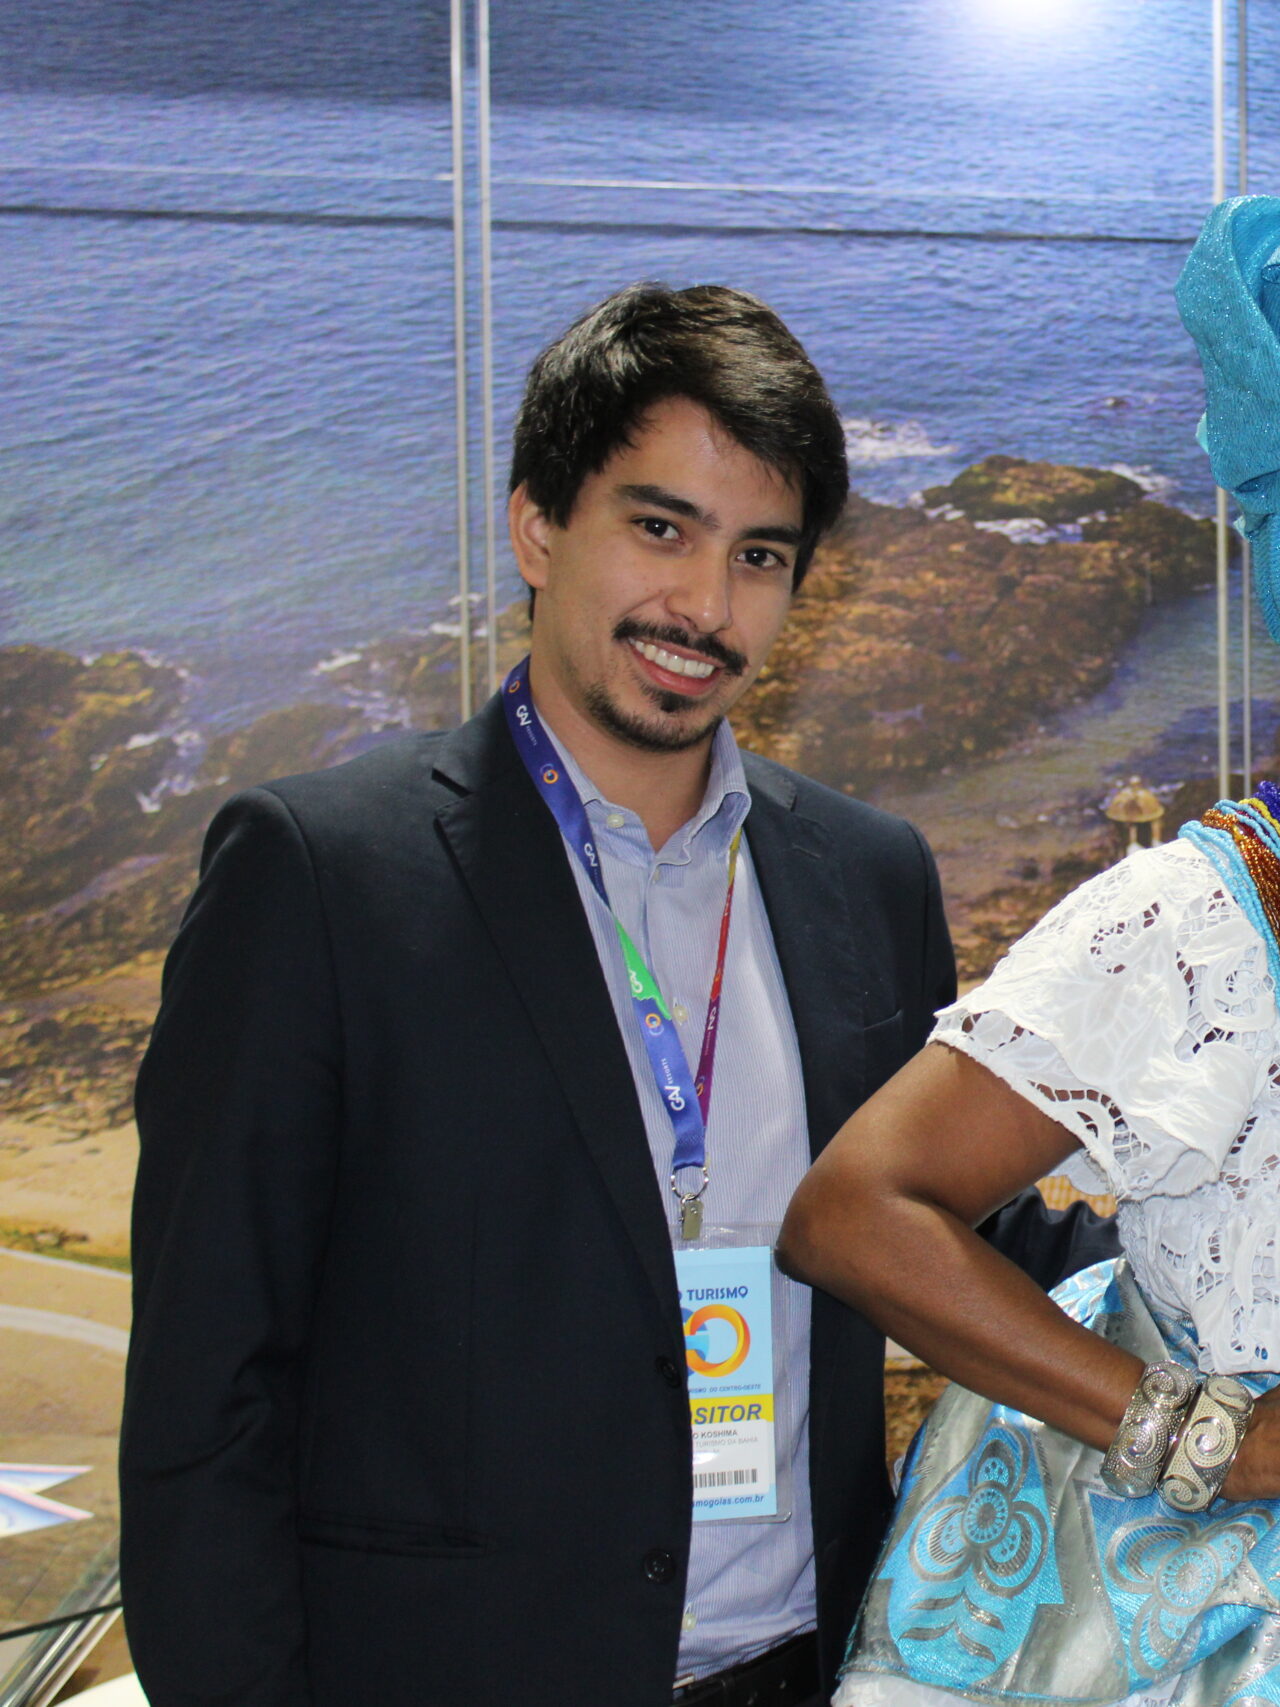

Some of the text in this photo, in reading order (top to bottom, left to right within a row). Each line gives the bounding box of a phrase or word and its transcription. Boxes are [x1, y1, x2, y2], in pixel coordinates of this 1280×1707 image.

[686, 1285, 749, 1301] TURISMO
[692, 1403, 762, 1425] SITOR
[701, 1429, 738, 1439] KOSHIMA
